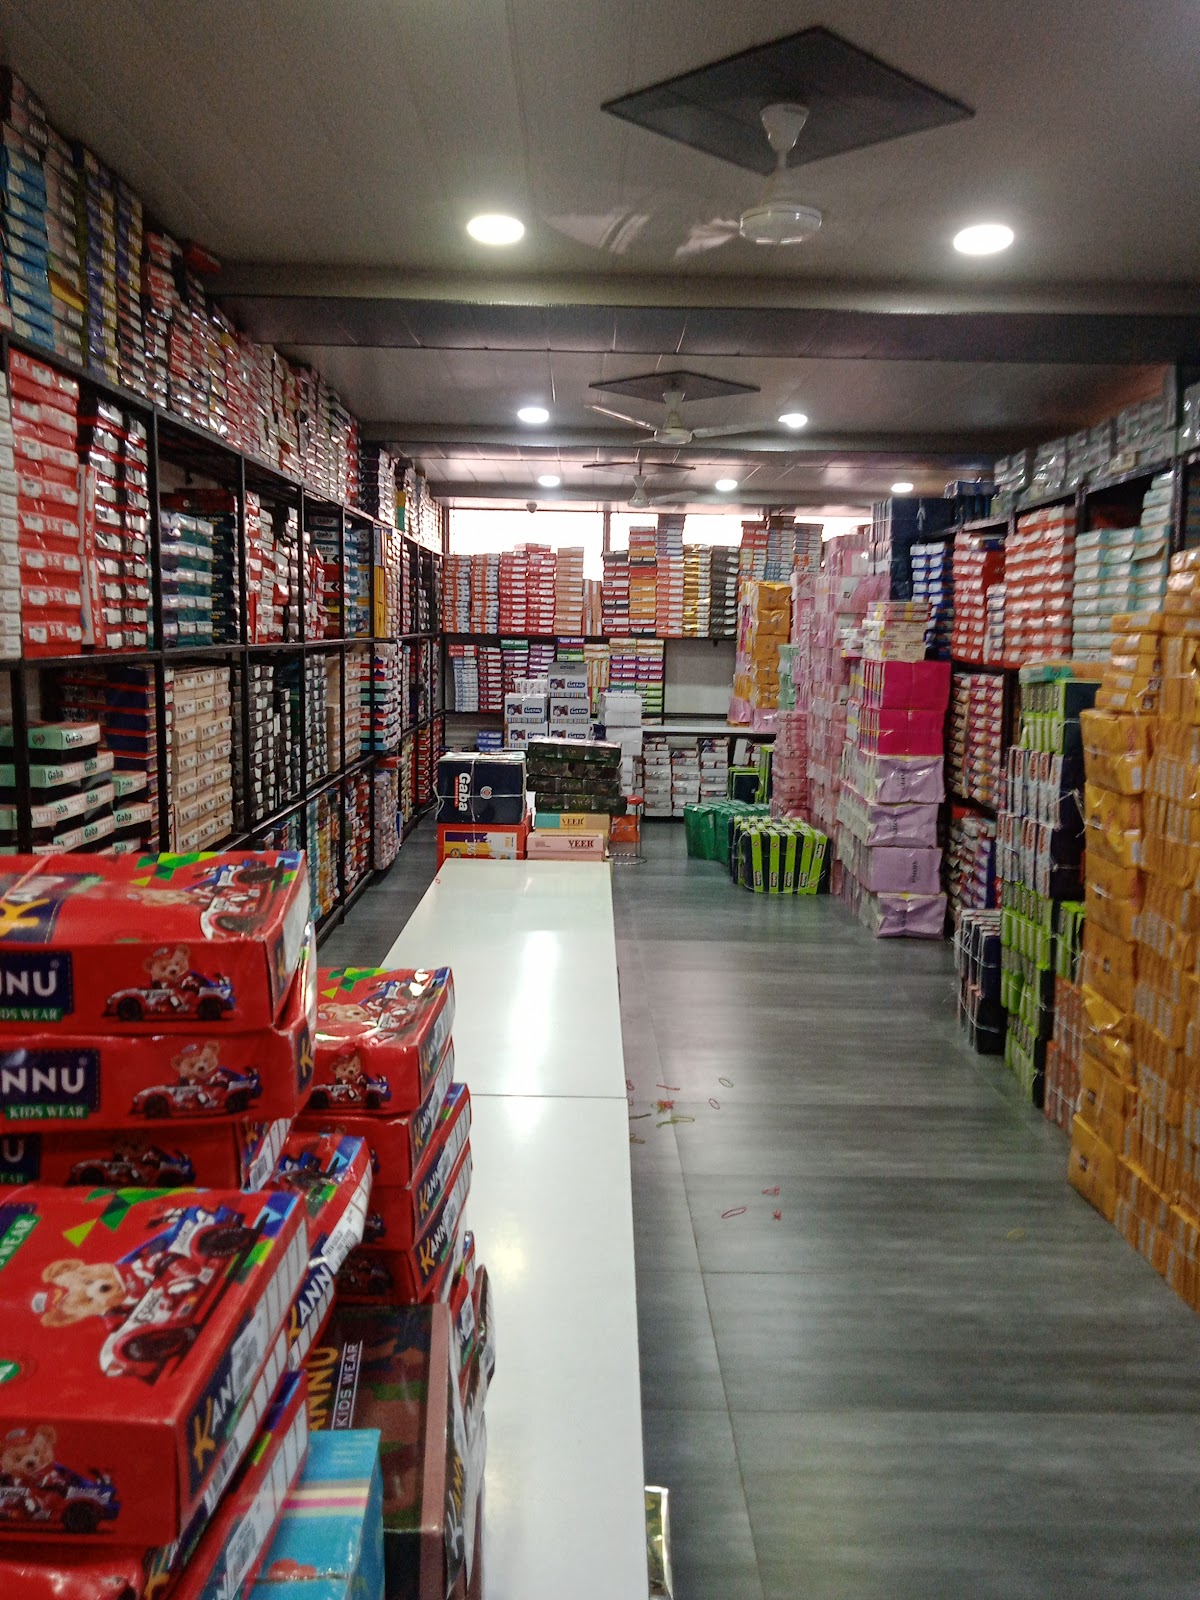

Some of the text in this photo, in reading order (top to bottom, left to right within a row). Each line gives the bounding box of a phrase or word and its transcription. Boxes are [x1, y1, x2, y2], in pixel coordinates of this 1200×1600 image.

[84, 760, 98, 772] Gaba
[48, 768, 63, 780] Gaba
[459, 772, 471, 811] Gaba
[116, 812, 132, 824] Gaba
[84, 825, 98, 838] Gaba
[20, 1008, 58, 1020] WEAR
[10, 1105, 84, 1119] KIDS WEAR
[336, 1344, 359, 1428] KIDS WEAR
